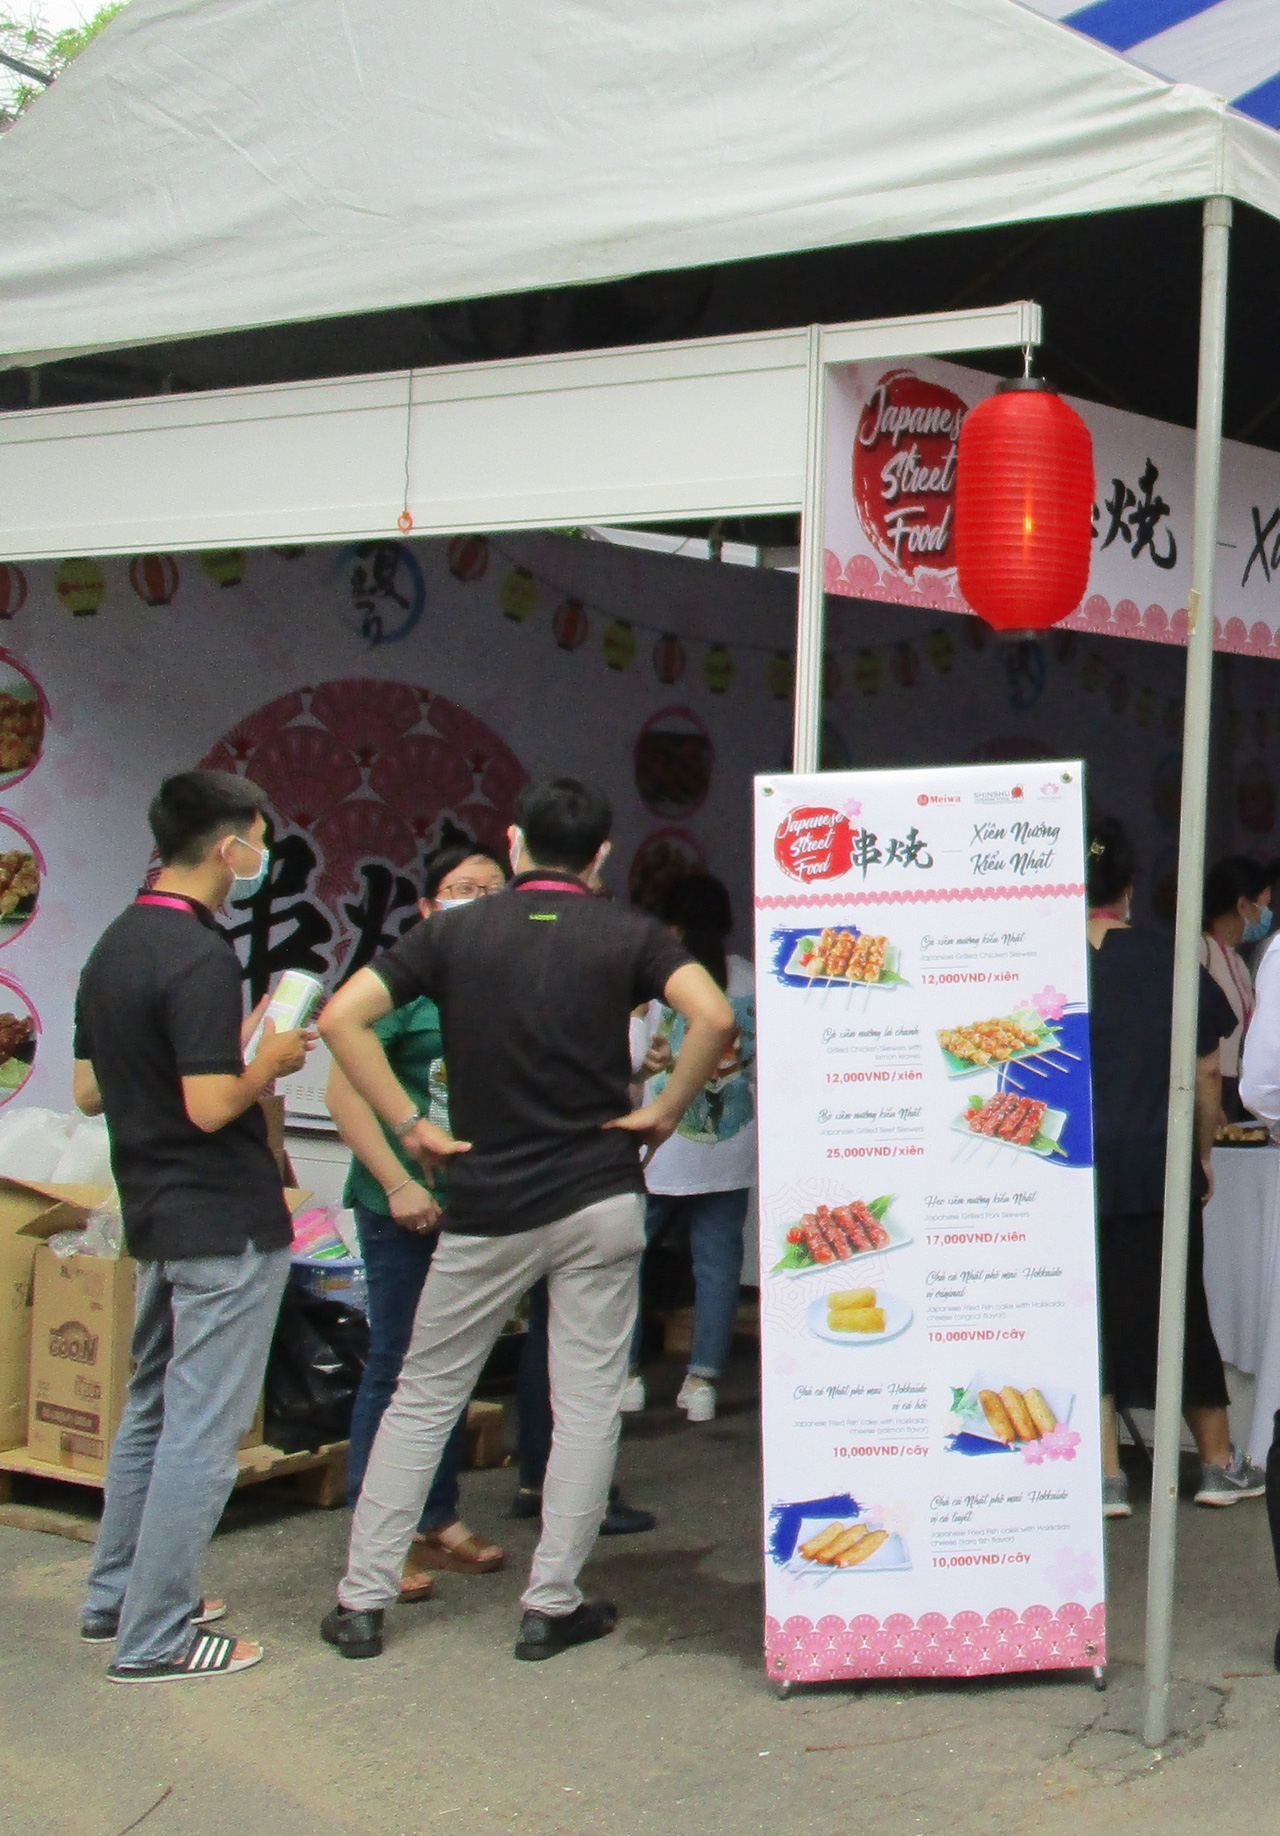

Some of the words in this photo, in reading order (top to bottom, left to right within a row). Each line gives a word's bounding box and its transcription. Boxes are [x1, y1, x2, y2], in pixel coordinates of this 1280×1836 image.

[859, 384, 963, 446] Japanes
[881, 443, 958, 500] Street
[884, 505, 951, 563] Food
[930, 794, 961, 803] Meiwa
[777, 812, 844, 839] Japanese
[970, 822, 1006, 847] Xiên
[1010, 821, 1060, 845] Nướng
[790, 829, 835, 857] Street
[793, 853, 831, 877] Food
[970, 850, 1006, 875] Kiểu
[1010, 849, 1056, 876] Nhật
